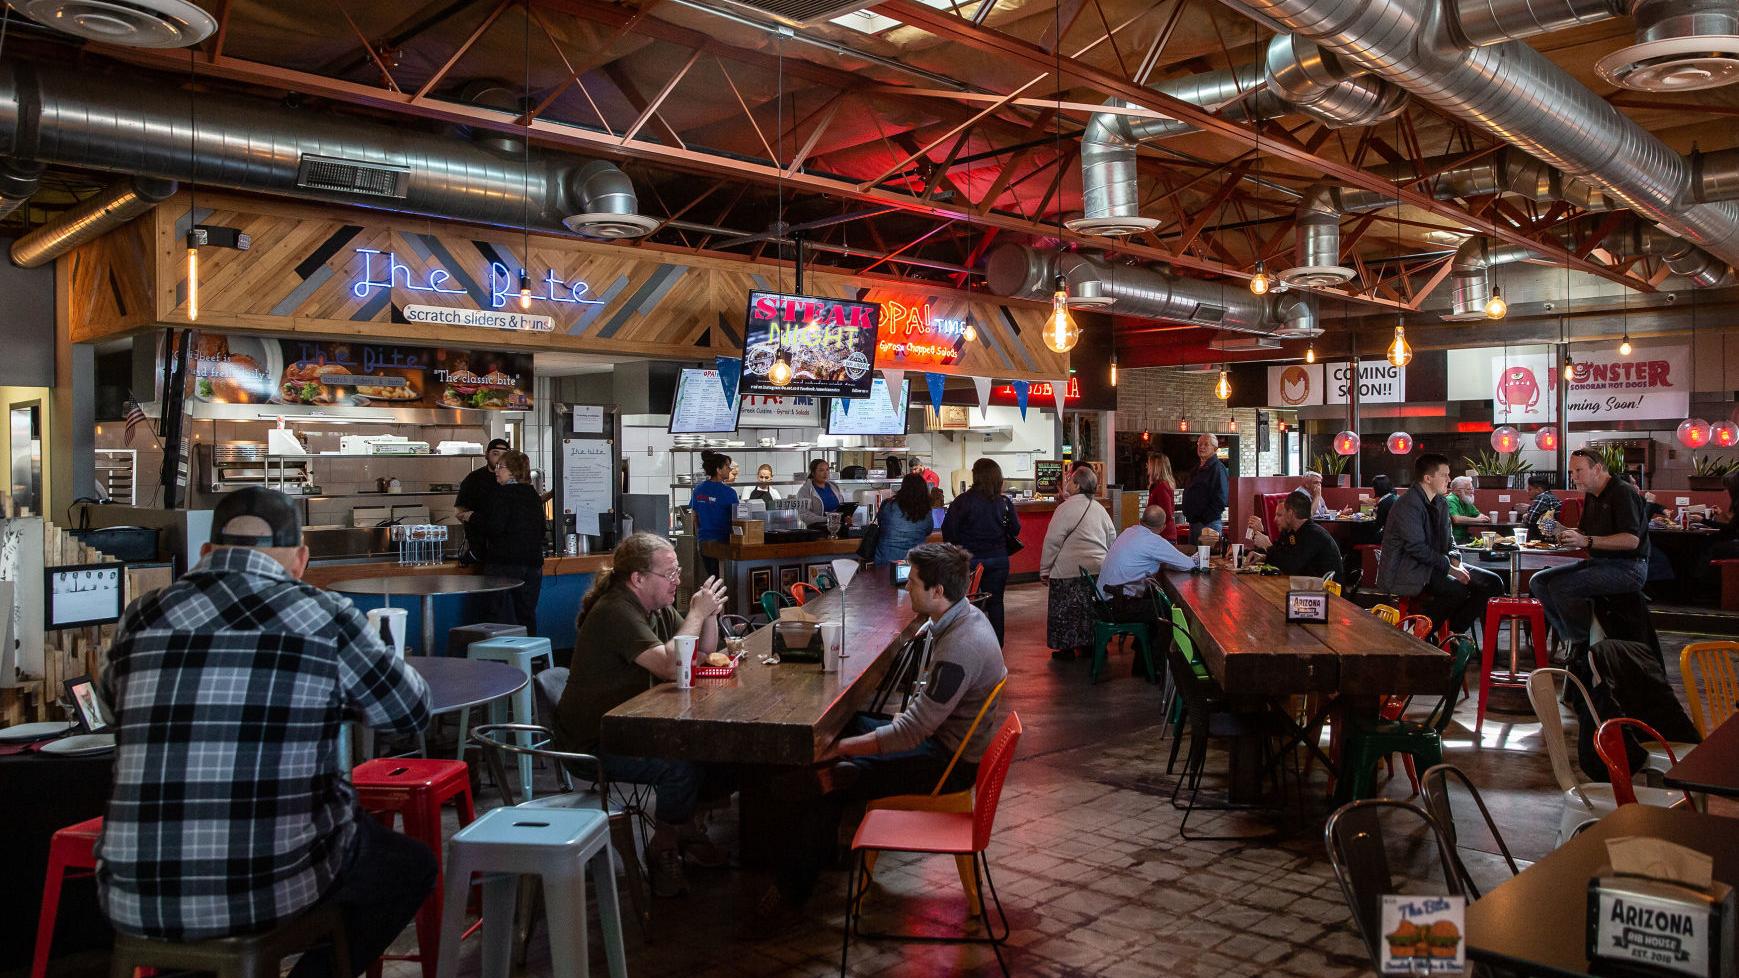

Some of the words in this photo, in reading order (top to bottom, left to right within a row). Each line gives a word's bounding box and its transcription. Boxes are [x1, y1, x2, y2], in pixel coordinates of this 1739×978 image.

[354, 248, 468, 298] The
[409, 309, 461, 323] scratch
[464, 313, 506, 327] sliders
[508, 315, 518, 327] &
[521, 316, 550, 330] buns
[754, 297, 875, 329] STEAK
[933, 318, 966, 334] TIME
[768, 321, 860, 350] NIGHT
[200, 351, 220, 362] beef
[296, 344, 357, 370] The
[363, 346, 427, 374] Bite
[462, 371, 495, 384] classic
[1333, 366, 1398, 380] COMING
[1338, 383, 1391, 397] SON!!
[1570, 383, 1606, 391] SONORAN
[1567, 398, 1600, 414] ming
[1605, 395, 1644, 411] Soon!
[1294, 597, 1321, 607] ARIZONA
[1398, 901, 1422, 920] The
[1610, 898, 1694, 937] ARIZONA
[1644, 935, 1678, 950] HOUSE
